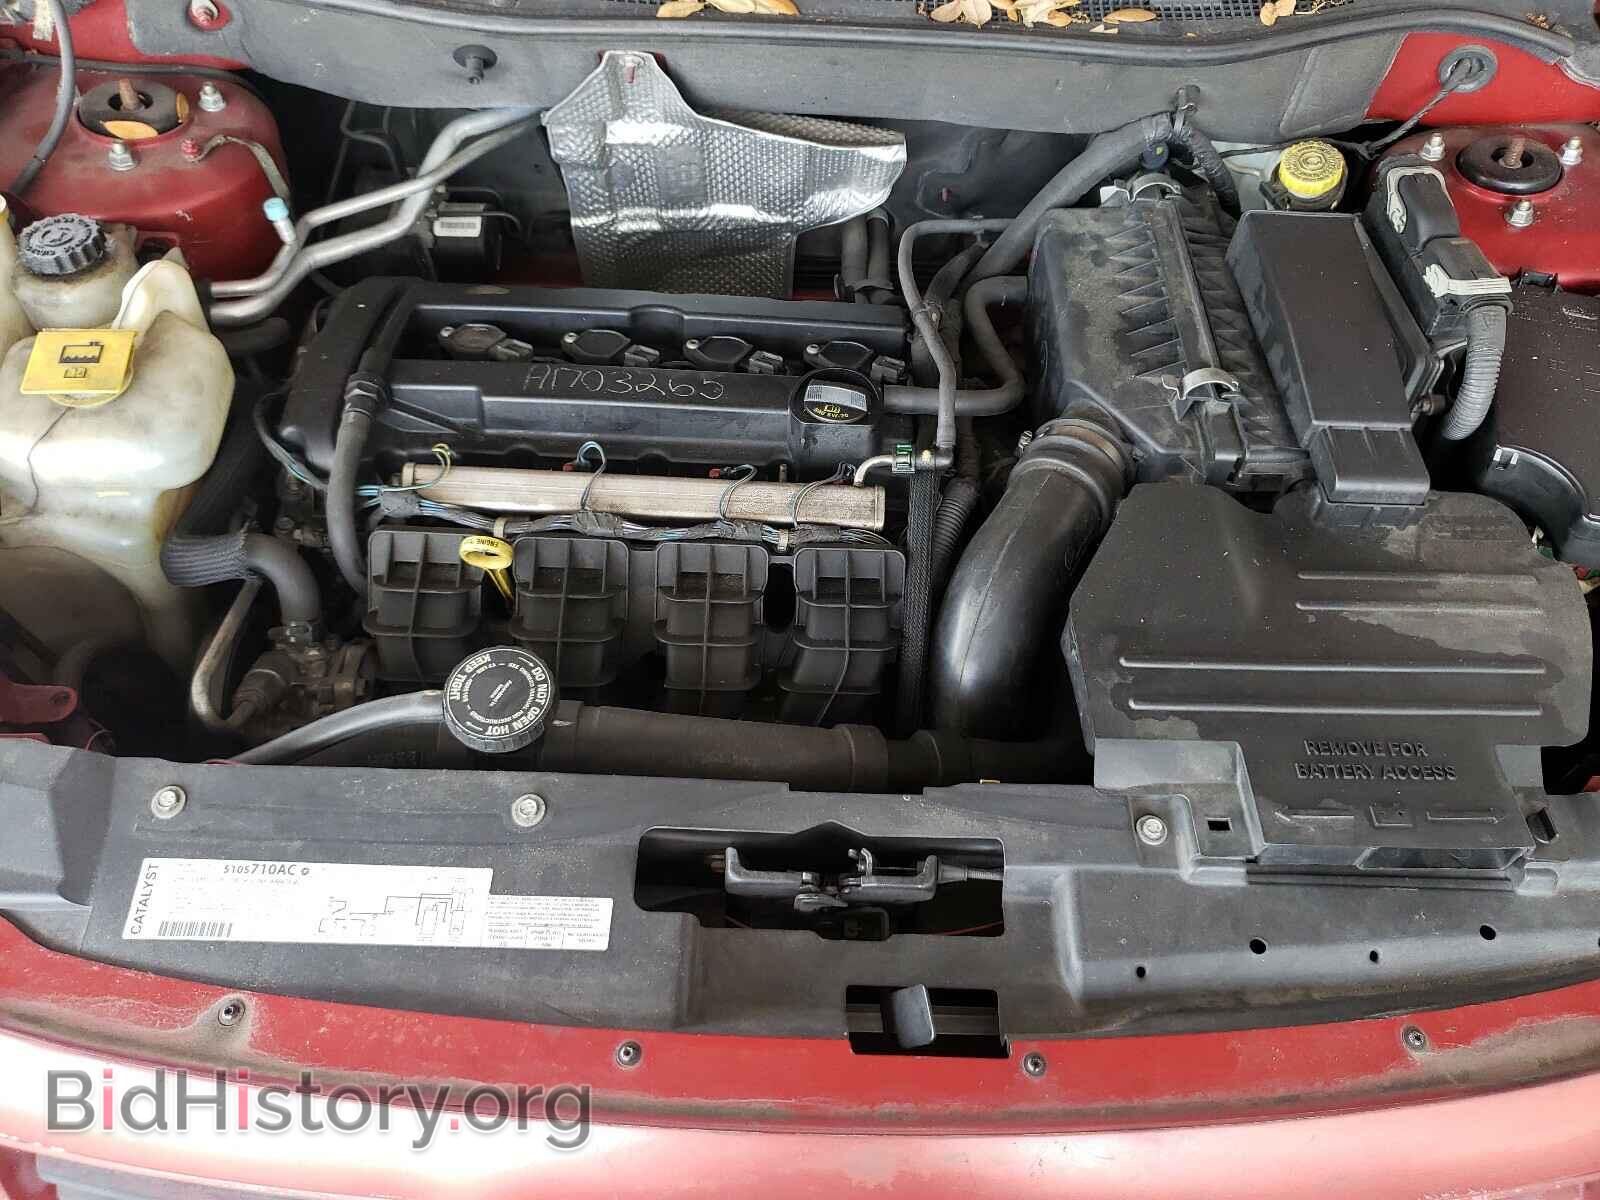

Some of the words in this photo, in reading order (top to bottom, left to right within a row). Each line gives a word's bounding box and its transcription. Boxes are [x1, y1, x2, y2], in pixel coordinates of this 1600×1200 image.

[477, 539, 499, 547] ENGINE
[464, 653, 492, 673] KEEP
[530, 667, 546, 682] DO
[449, 674, 468, 701] TIGHT
[537, 683, 548, 705] NOT
[512, 706, 541, 731] OPEN
[485, 725, 510, 736] HOT
[1303, 739, 1386, 757] REMOVE
[1389, 742, 1429, 758] FOR
[1294, 762, 1374, 780] BATTERY
[1383, 764, 1457, 781] ACCESS
[223, 863, 297, 876] 5105710AC
[130, 864, 160, 935] CATALYST
